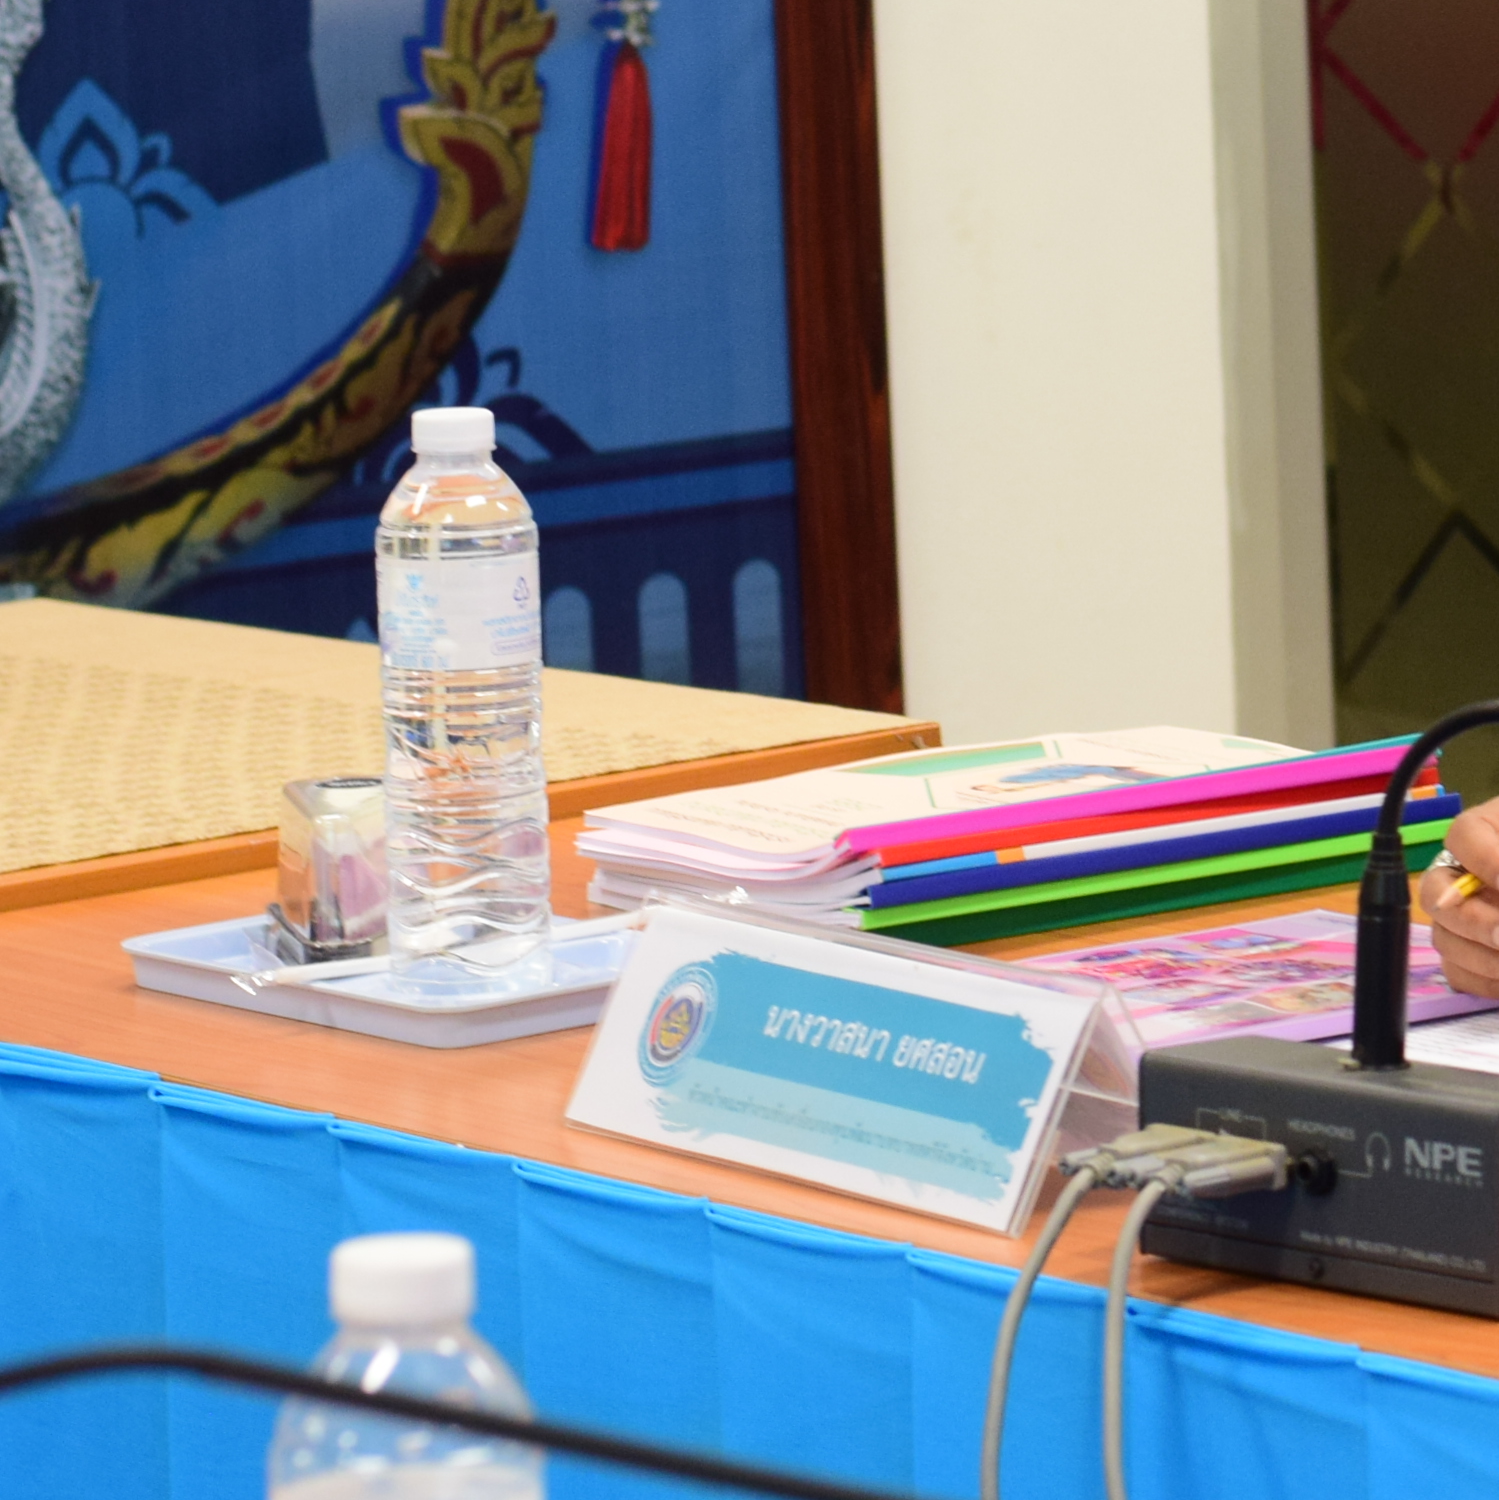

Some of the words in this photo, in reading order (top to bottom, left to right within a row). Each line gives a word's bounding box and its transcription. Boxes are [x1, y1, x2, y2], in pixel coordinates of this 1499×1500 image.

[763, 1005, 891, 1062] นางวาสนา
[1404, 1136, 1484, 1178] NPE
